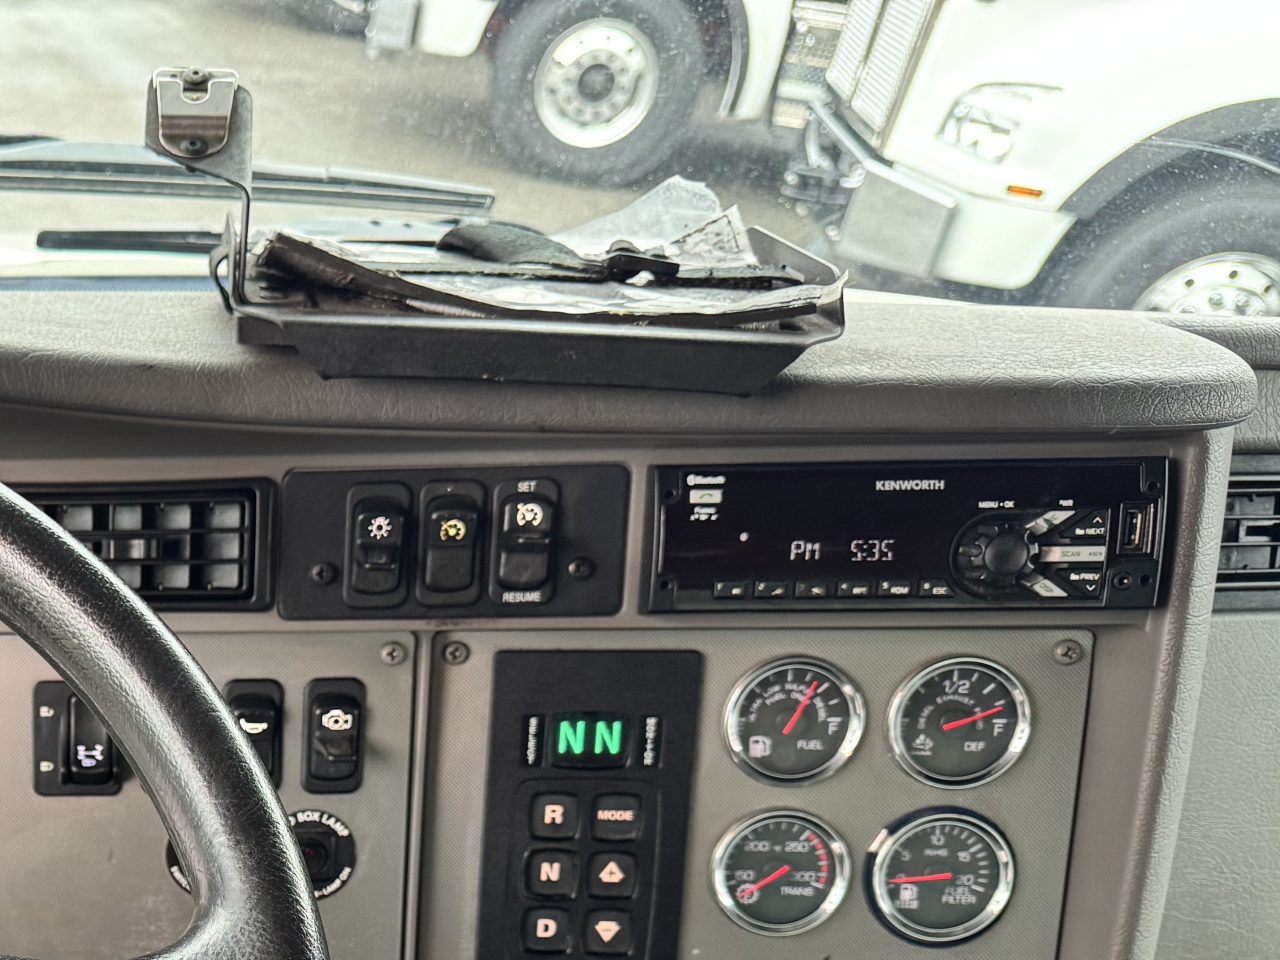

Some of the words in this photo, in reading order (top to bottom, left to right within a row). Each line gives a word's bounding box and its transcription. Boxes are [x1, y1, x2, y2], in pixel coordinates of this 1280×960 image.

[517, 481, 537, 492] SET
[875, 480, 945, 491] KENWORTH
[1085, 527, 1105, 535] NEXT
[790, 540, 821, 560] PM
[850, 540, 896, 561] 5:35
[1061, 550, 1080, 558] SCAN
[502, 591, 542, 602] RESUME
[942, 680, 970, 694] 1/2
[827, 722, 838, 735] F
[993, 724, 1004, 736] F
[797, 740, 824, 750] FUEL
[964, 741, 985, 752] DEF
[544, 804, 565, 824] R
[597, 809, 634, 820] MODE
[297, 811, 322, 823] BOX
[321, 813, 350, 837] LAMP
[540, 862, 561, 881] N
[536, 918, 558, 938] D
